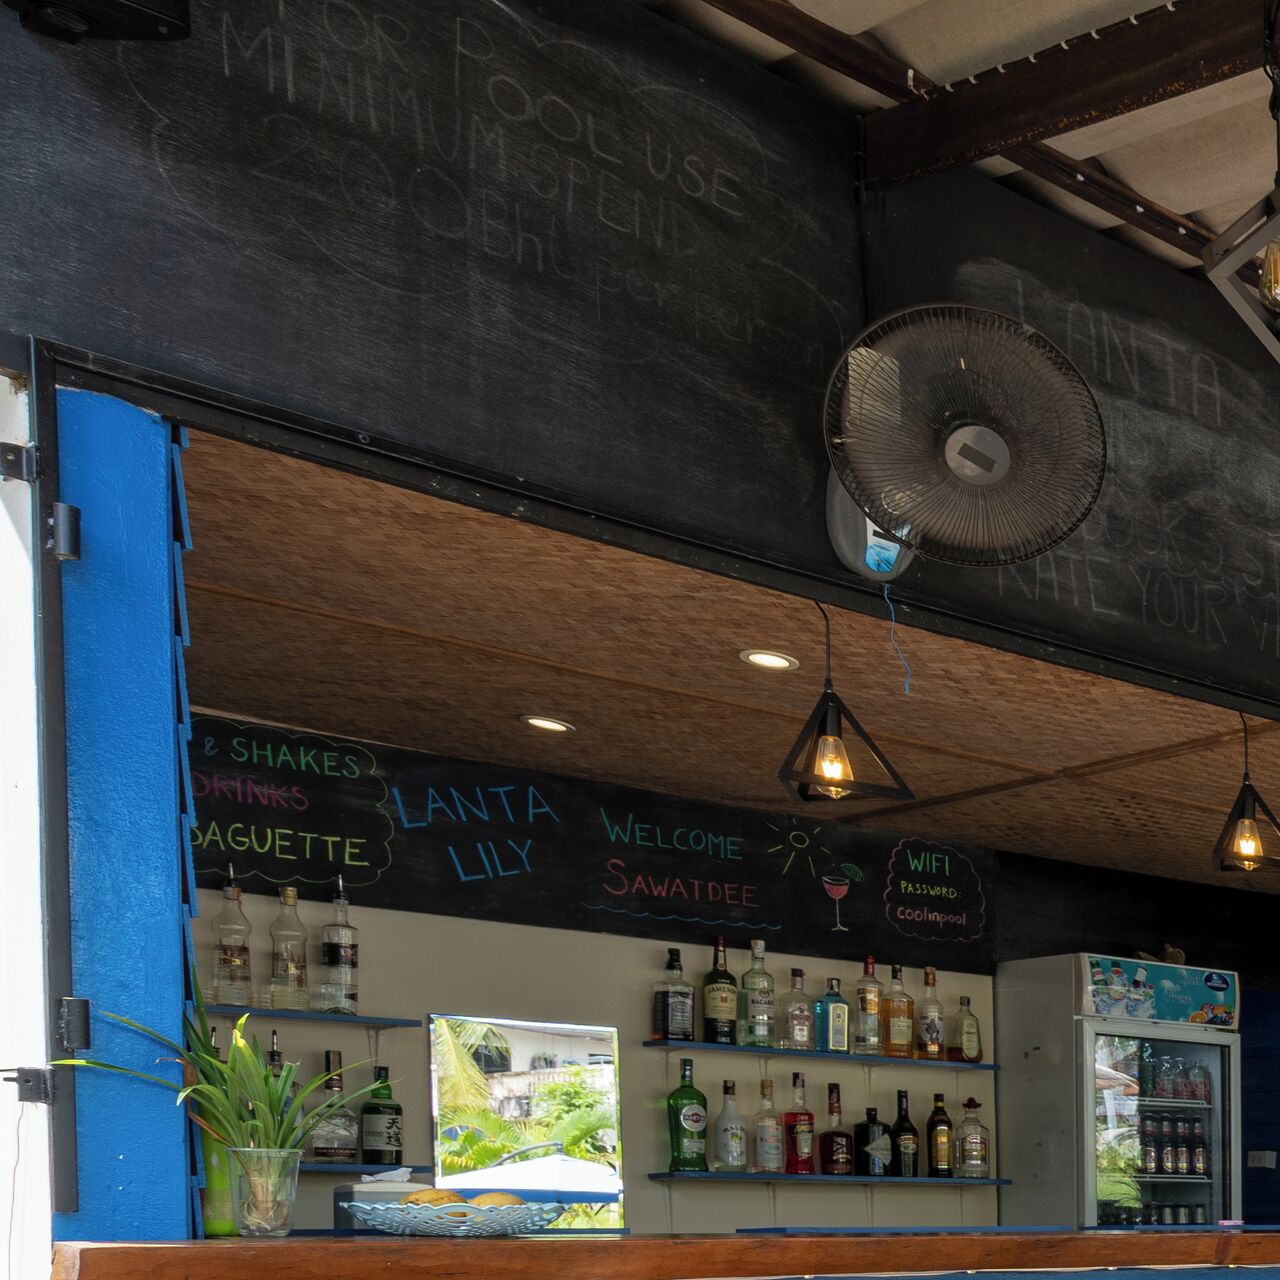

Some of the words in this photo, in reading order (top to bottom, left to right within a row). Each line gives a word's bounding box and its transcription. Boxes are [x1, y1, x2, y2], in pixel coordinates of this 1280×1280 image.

[277, 0, 409, 72] OR
[454, 16, 624, 166] POOL
[646, 132, 745, 217] USE
[222, 11, 507, 182] MINIMUM
[529, 144, 700, 255] SPEND
[250, 113, 471, 238] 200
[1128, 562, 1229, 646] YOUR
[229, 736, 361, 779] SHAKES
[191, 771, 310, 811] DRINKS
[391, 785, 560, 829] LANTA
[600, 807, 746, 861] WELCOME
[448, 839, 532, 882] LILY
[602, 858, 760, 908] SAWATDEE
[907, 848, 950, 877] WIFI
[385, 1117, 402, 1148] 天道
